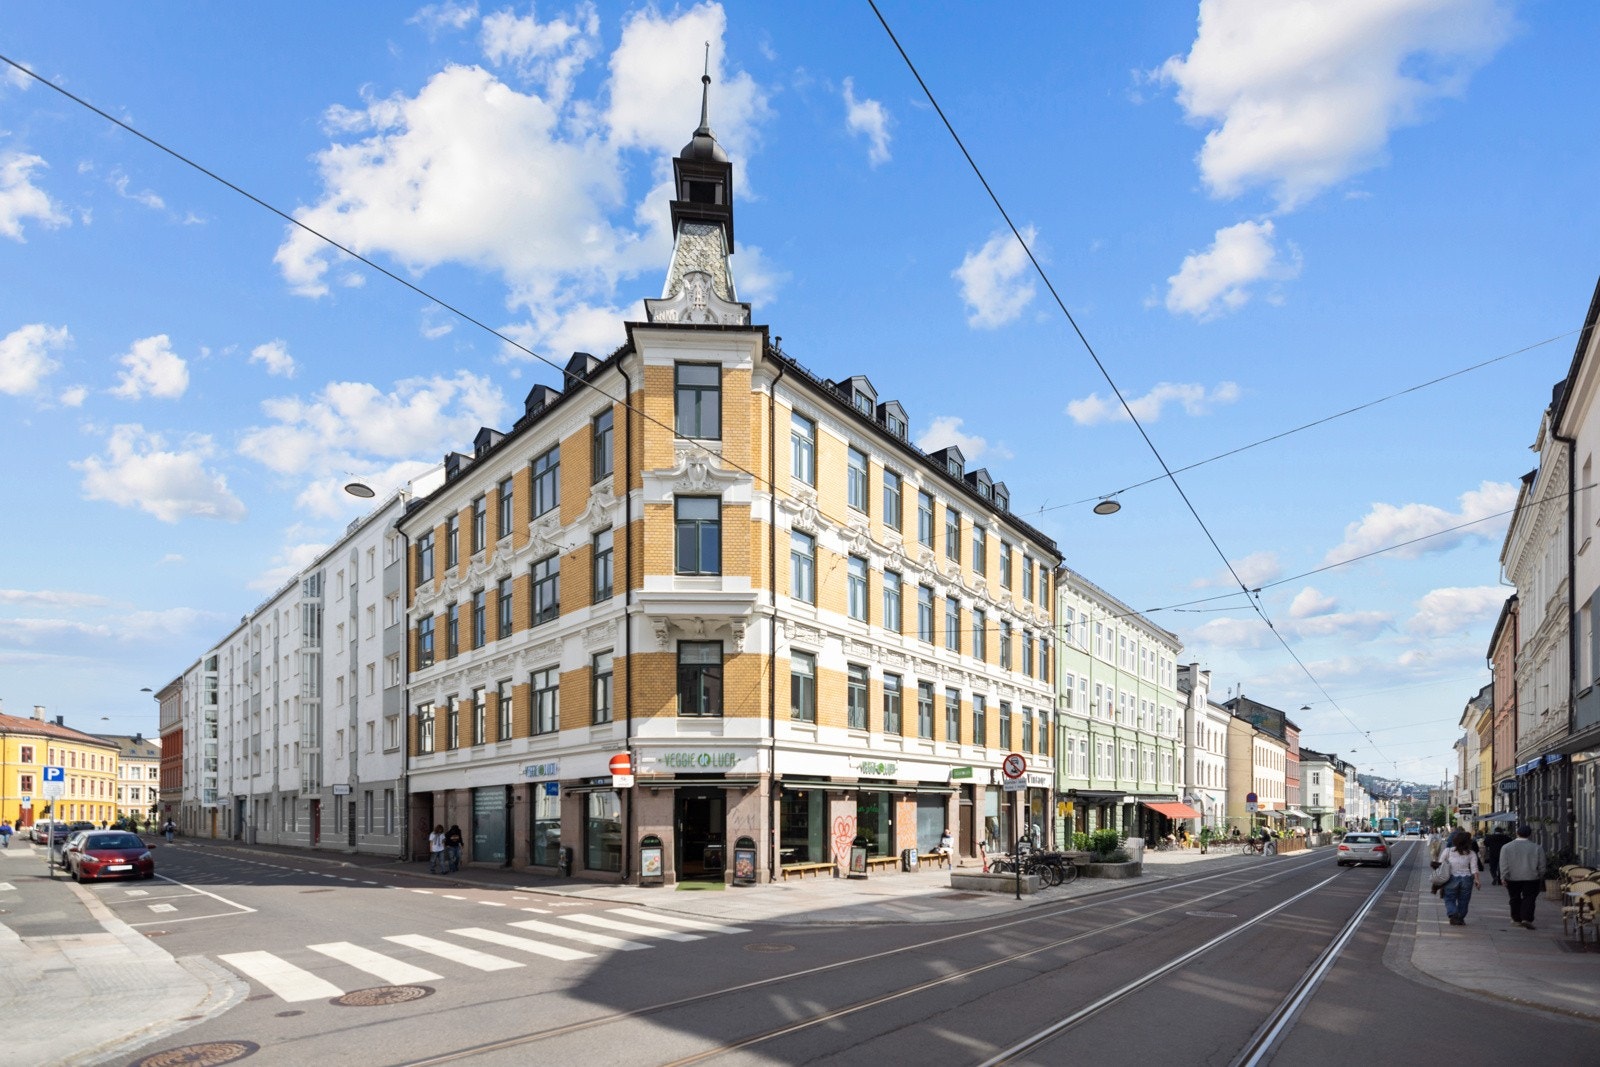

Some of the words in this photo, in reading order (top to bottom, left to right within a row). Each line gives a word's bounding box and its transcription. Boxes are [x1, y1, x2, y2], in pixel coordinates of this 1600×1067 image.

[664, 752, 696, 768] VEGGIE
[712, 752, 736, 768] LUCA
[47, 768, 60, 780] P
